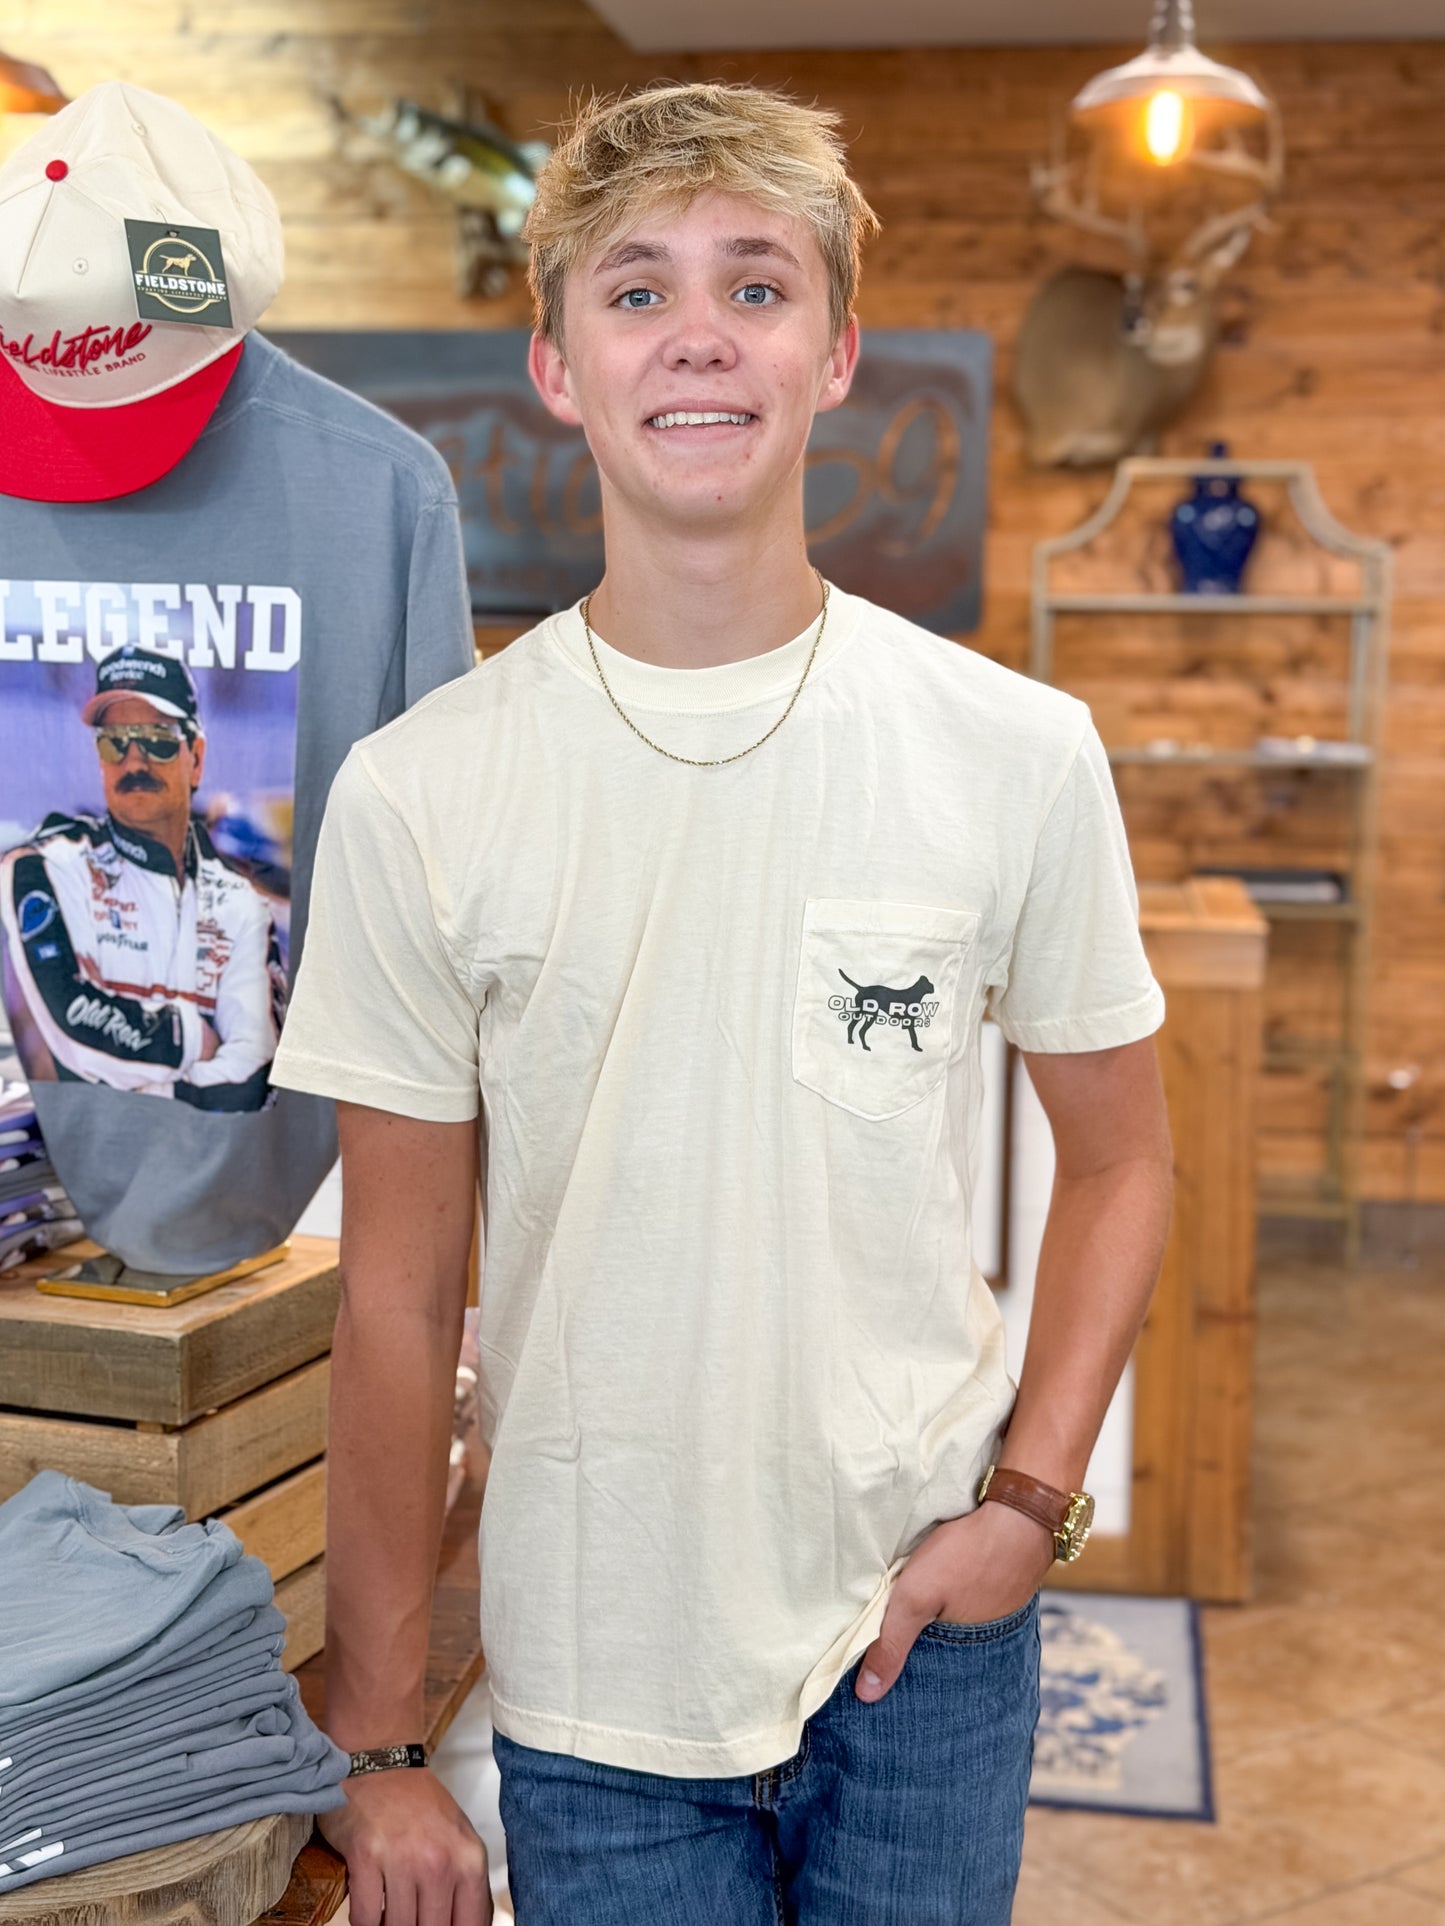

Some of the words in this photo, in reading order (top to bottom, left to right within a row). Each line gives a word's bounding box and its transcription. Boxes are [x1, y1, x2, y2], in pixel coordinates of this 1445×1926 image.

[135, 273, 226, 296] FIELDSTONE
[0, 321, 152, 370] ieldstone
[42, 366, 101, 377] LIFESTYLE
[105, 352, 146, 373] BRAND
[0, 579, 302, 672] LEGEND
[828, 994, 879, 1013] OLD
[888, 1001, 940, 1018] ROW
[66, 994, 112, 1030] Old
[102, 1006, 152, 1052] Row
[838, 1011, 931, 1028] OUTDOORS
